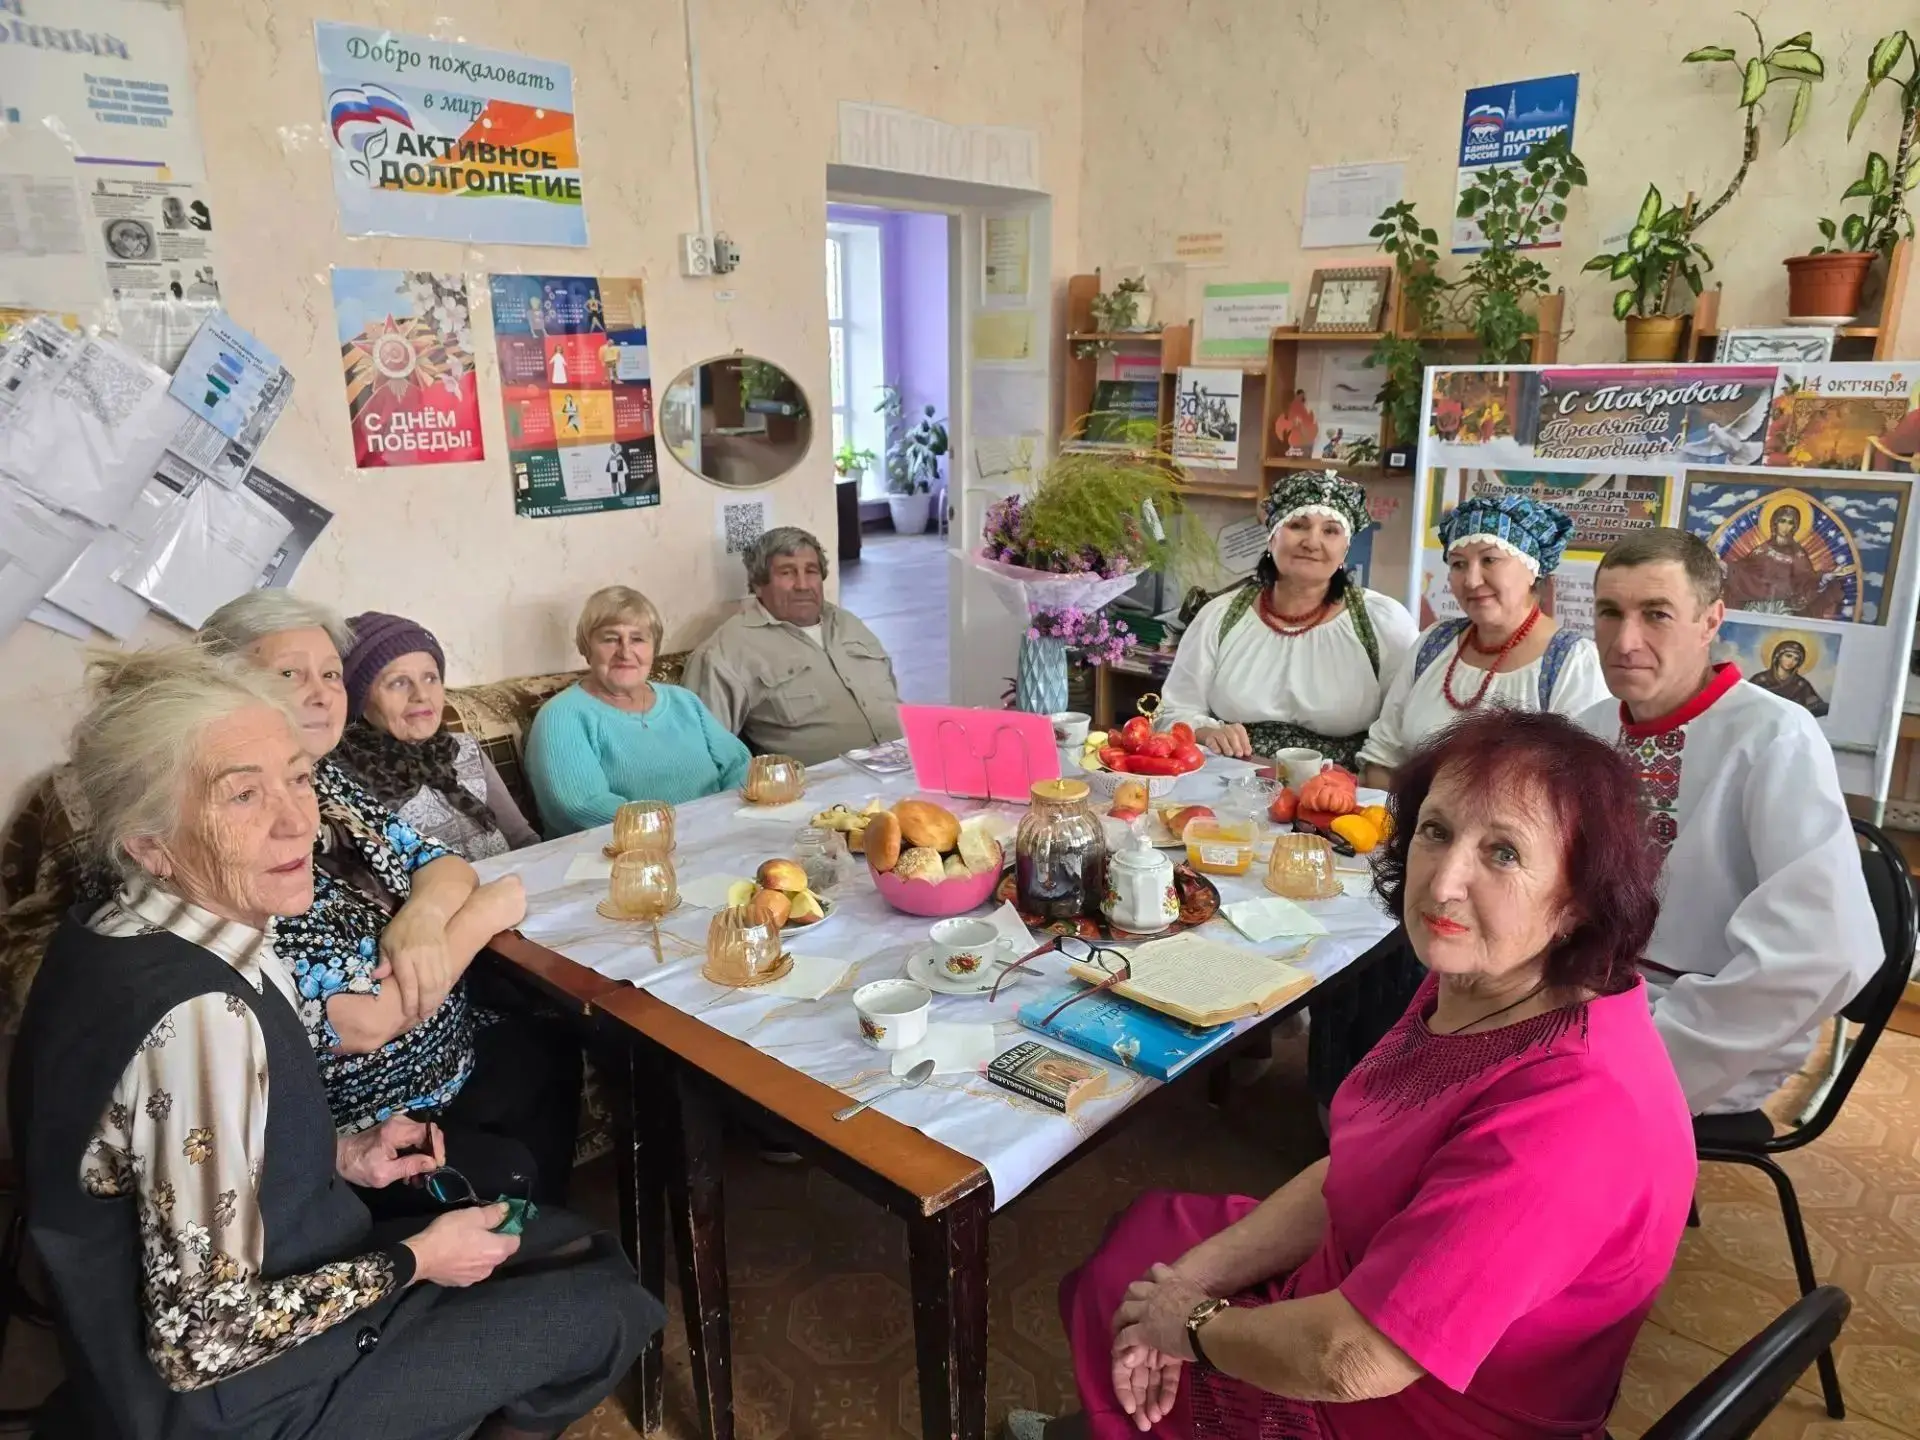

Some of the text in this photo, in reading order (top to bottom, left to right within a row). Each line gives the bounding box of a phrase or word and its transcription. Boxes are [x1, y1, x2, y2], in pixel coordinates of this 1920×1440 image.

[346, 37, 555, 92] Добро пожаловать
[423, 93, 482, 122] в мир
[395, 132, 558, 170] АКТИВНОЕ
[1464, 150, 1500, 161] РОССИЯ
[1465, 142, 1500, 153] ЕДИНАЯ
[1502, 139, 1548, 157] ПУТ
[379, 159, 583, 200] ДОЛГОЛЕТИЕ
[1558, 380, 1743, 414] С Покровом
[1801, 374, 1908, 396] 14 октября
[1181, 397, 1198, 416] 20
[364, 406, 457, 434] С ДНЁМ
[1180, 416, 1197, 434] 26
[1538, 411, 1671, 443] Пресвятой
[367, 430, 474, 454] ПОБЕДЫ!
[1541, 433, 1683, 461] Богородицы!
[1483, 483, 1539, 495] Покровом
[1092, 1003, 1133, 1027] УТРО
